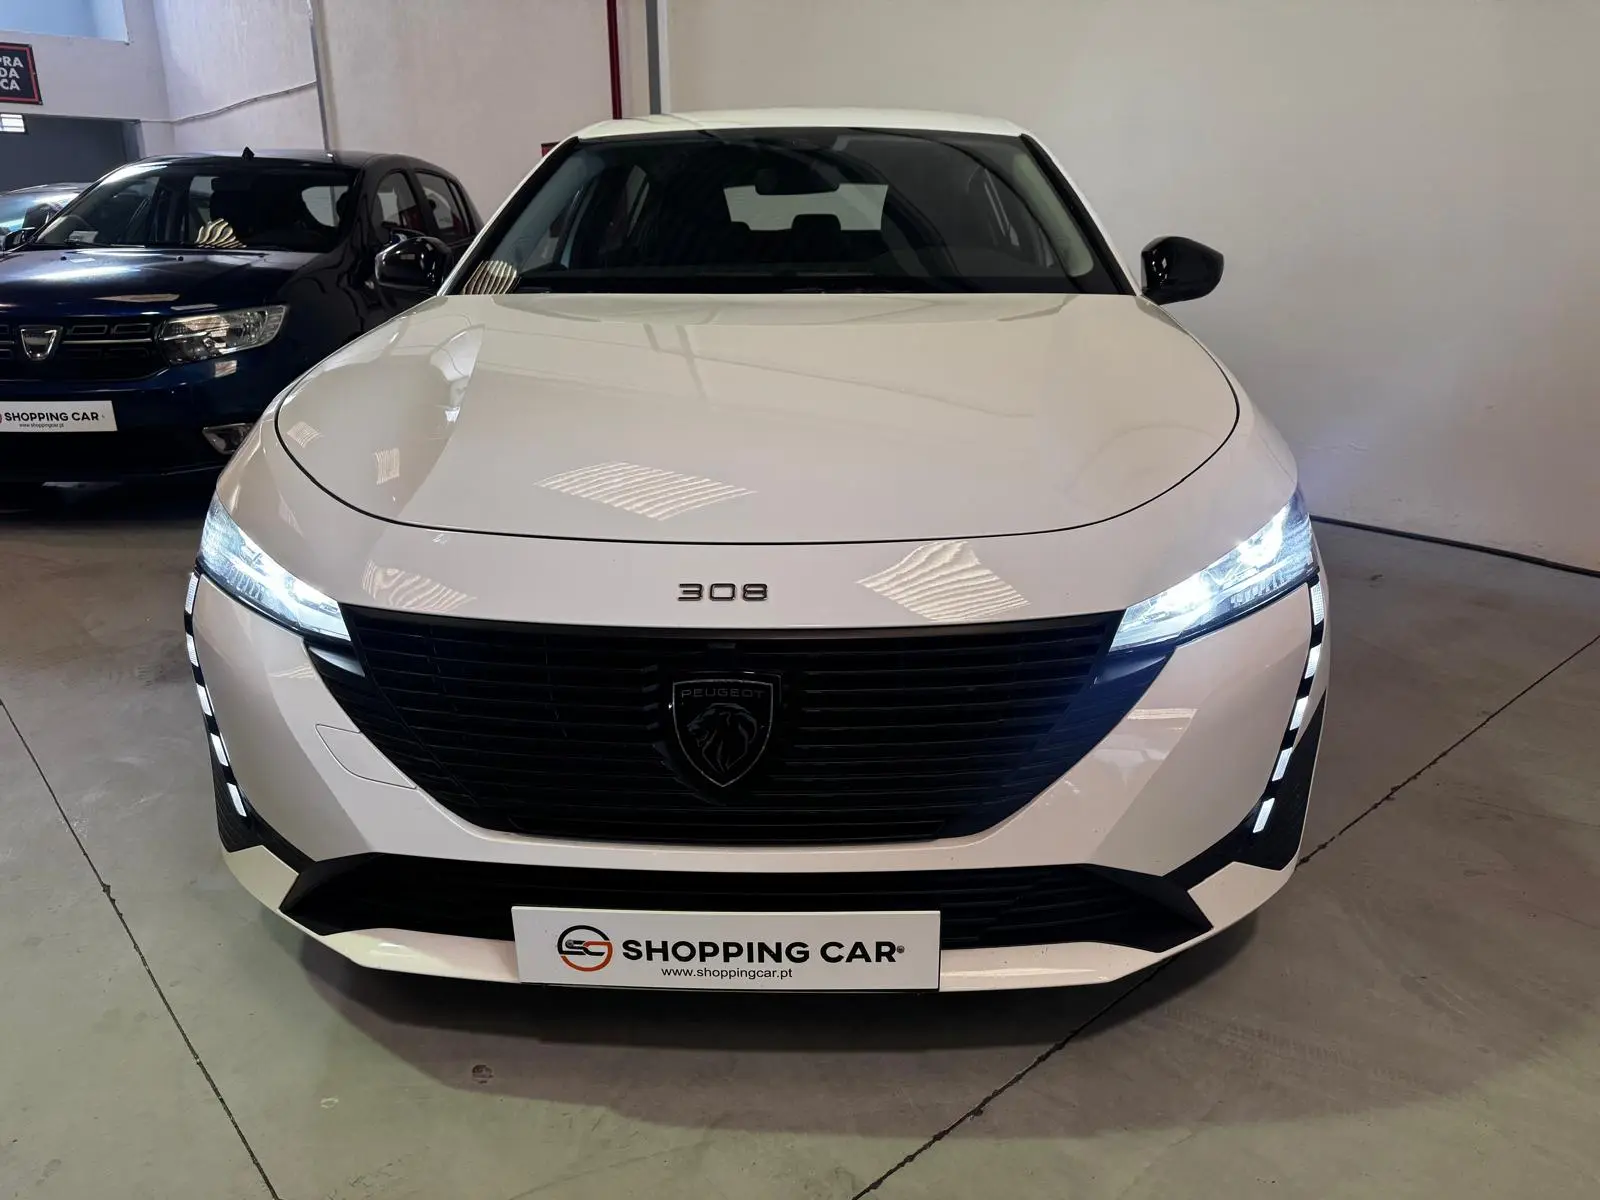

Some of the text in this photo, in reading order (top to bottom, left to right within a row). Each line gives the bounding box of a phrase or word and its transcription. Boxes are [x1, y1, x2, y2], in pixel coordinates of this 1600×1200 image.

[3, 412, 99, 421] SHOPPING CAR
[677, 582, 768, 602] 308
[681, 688, 765, 699] PEUGEOT
[621, 939, 810, 964] SHOPPING
[660, 967, 793, 981] www.shoppingcar.pt
